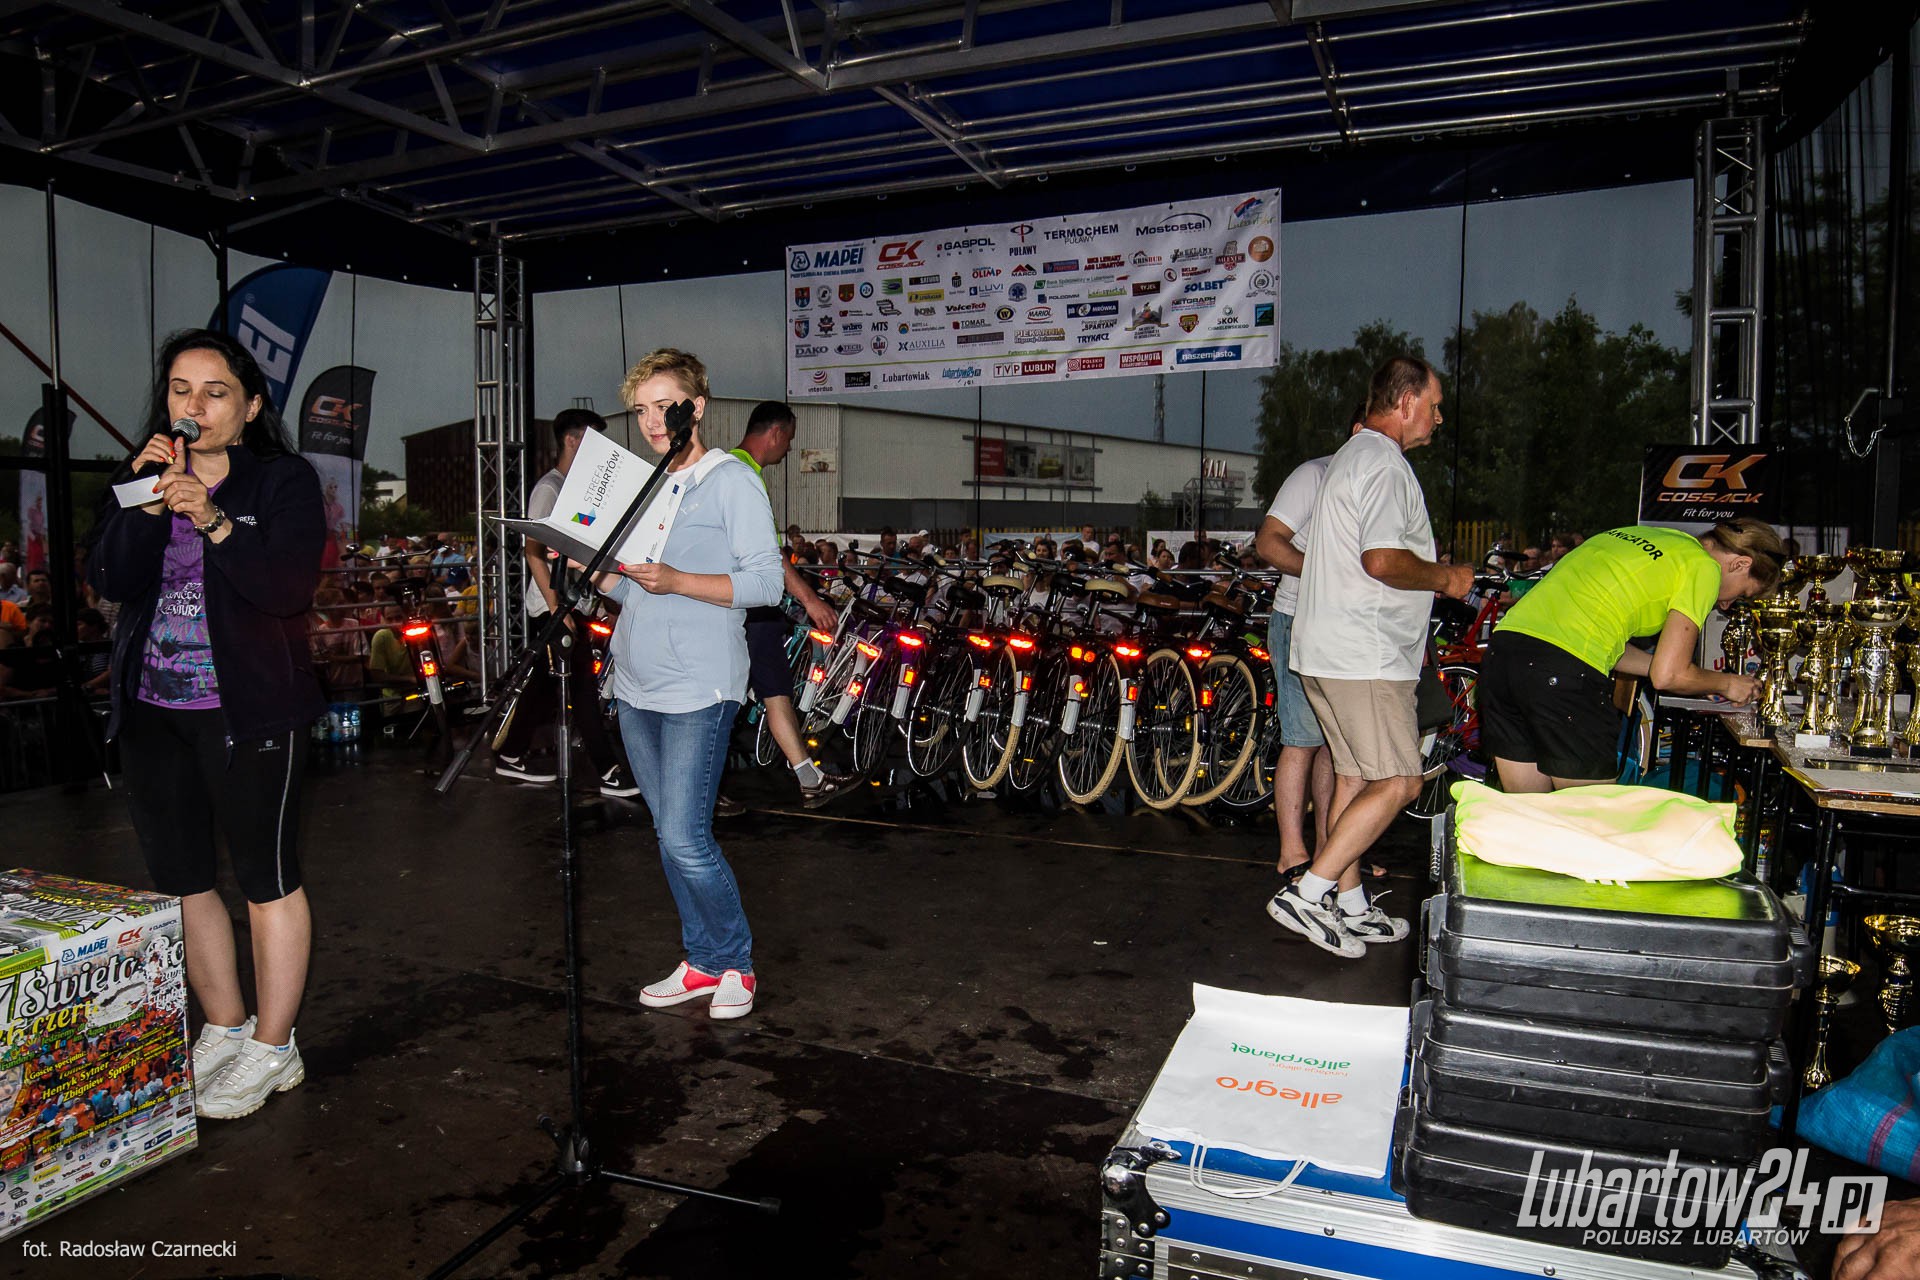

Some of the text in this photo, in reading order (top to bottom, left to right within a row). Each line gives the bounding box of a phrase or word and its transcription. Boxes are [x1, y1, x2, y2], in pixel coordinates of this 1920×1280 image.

[1044, 223, 1119, 240] TERMOCHEM
[1135, 219, 1205, 236] Mostostal
[944, 238, 995, 250] GASPOL
[1009, 245, 1037, 256] PUŁAWY
[813, 247, 865, 268] MAPEI
[879, 240, 924, 262] CK
[972, 268, 1002, 279] OLIMP
[979, 283, 1003, 292] LUVI
[1184, 280, 1226, 293] SOLBET
[871, 321, 889, 332] MTS
[1216, 316, 1239, 326] SKOK
[909, 339, 945, 348] AUXILIA
[796, 346, 829, 355] DAKO
[995, 363, 1054, 375] TVP LUBLIN
[882, 371, 930, 383] Lubartowiak
[1662, 454, 1768, 489] CK
[584, 464, 605, 504] STREFA
[592, 449, 620, 508] LUBARTÓW
[1656, 492, 1764, 504] COSSACK
[1682, 508, 1735, 520] Fit for you
[77, 937, 109, 958] MAPEI
[1230, 1041, 1352, 1071] allforplanet
[41, 1076, 78, 1101] Henryk
[79, 1061, 109, 1081] Sytner
[62, 1077, 105, 1104] Zbigniew
[107, 1058, 138, 1079] Spruch
[1215, 1076, 1344, 1109] allegro
